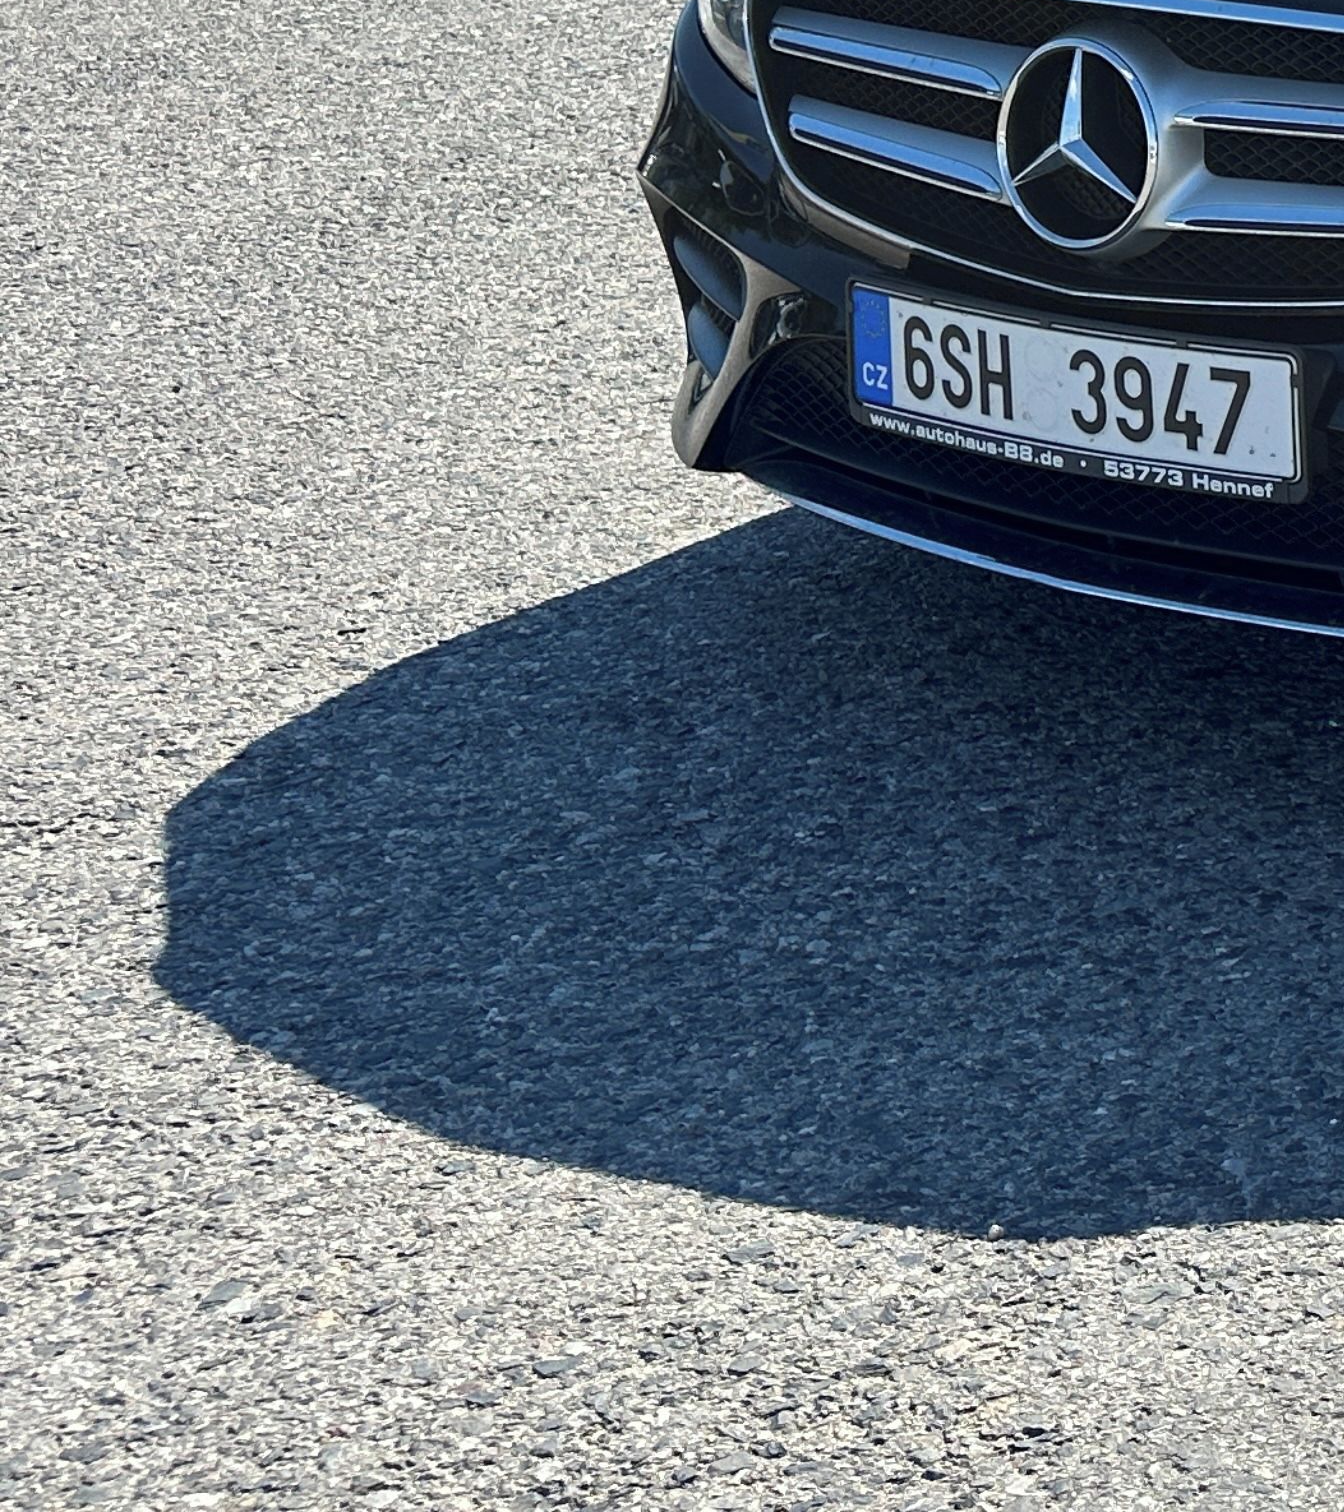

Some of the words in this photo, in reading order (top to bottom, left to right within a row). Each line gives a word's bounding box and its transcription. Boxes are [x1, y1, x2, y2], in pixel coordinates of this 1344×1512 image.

[862, 361, 889, 390] CZ
[903, 315, 1015, 421] 6SH
[1069, 348, 1252, 456] 3947
[1103, 459, 1184, 488] 53773
[1192, 472, 1275, 499] Hennef
